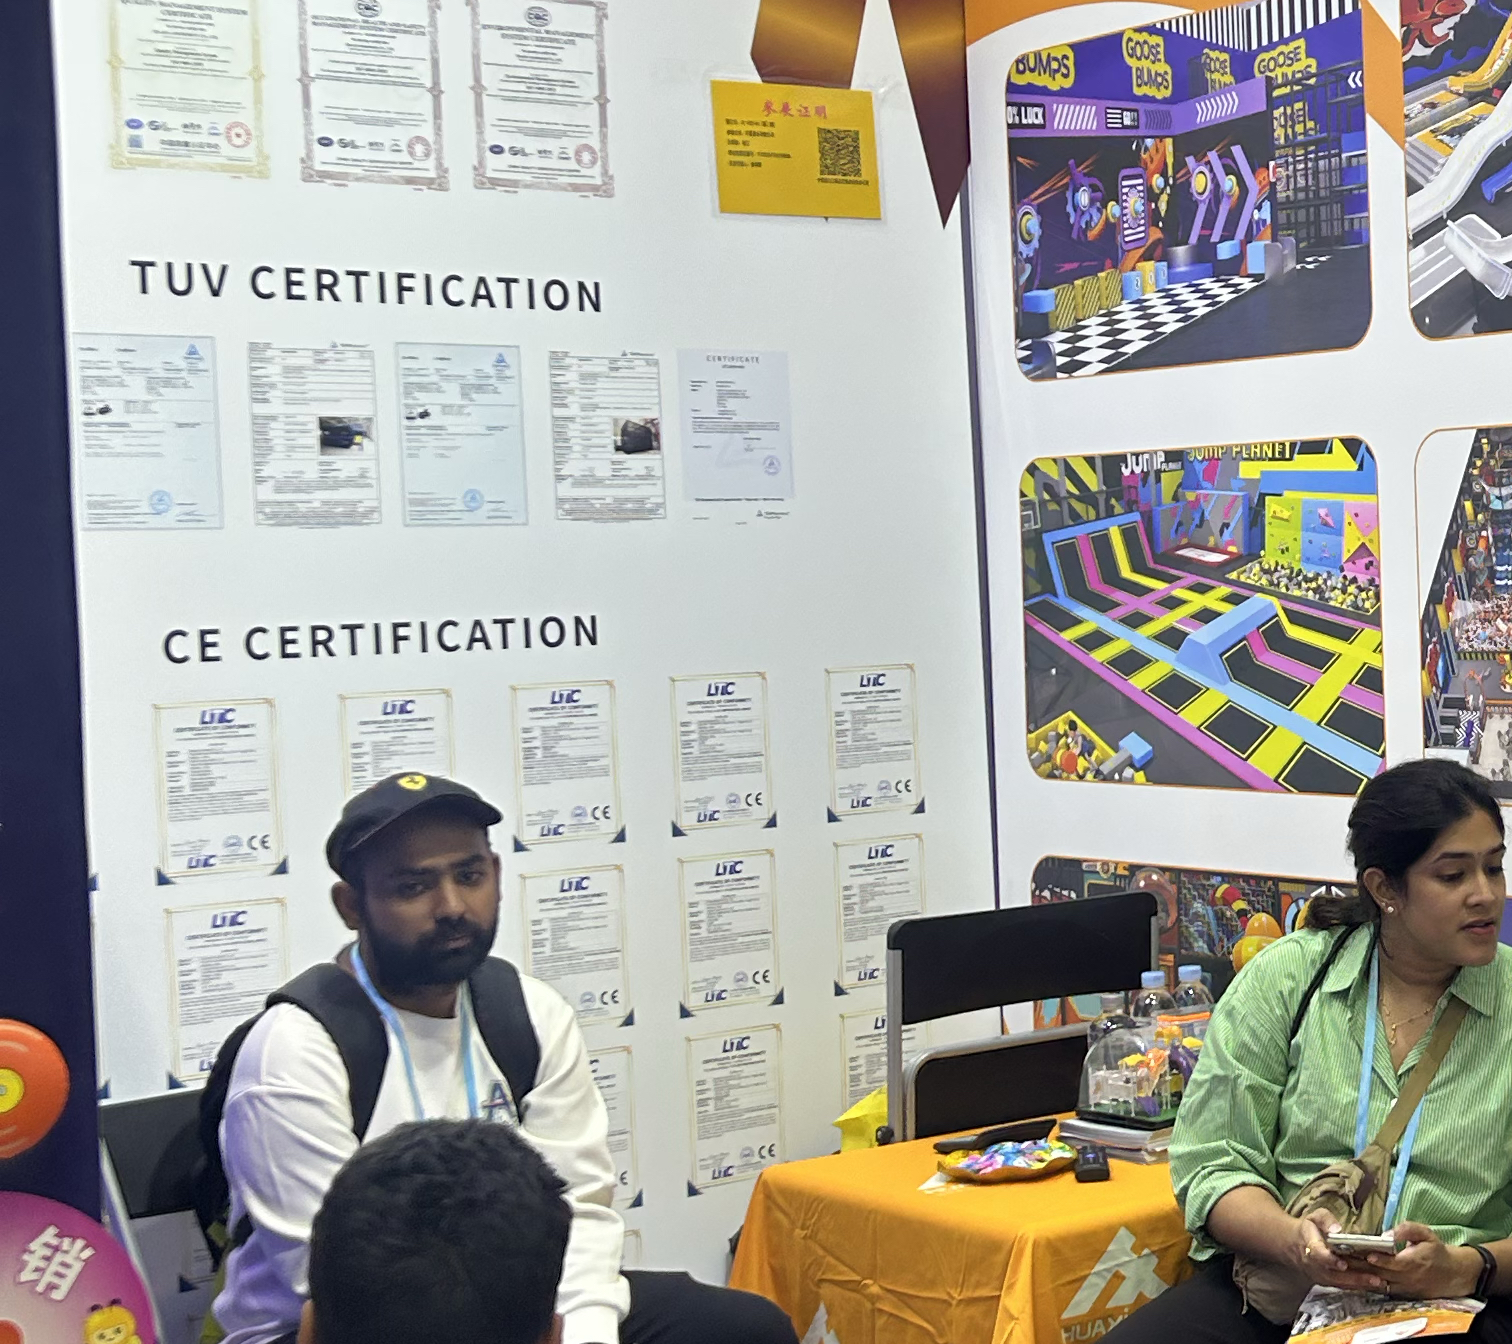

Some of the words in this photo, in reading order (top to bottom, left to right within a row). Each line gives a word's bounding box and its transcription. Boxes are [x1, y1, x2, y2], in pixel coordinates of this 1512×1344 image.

[129, 260, 229, 298] TUV
[248, 265, 604, 314] CERTIFICATION
[161, 627, 224, 666] CE
[243, 614, 602, 662] CERTIFICATION
[18, 1223, 97, 1302] 销
